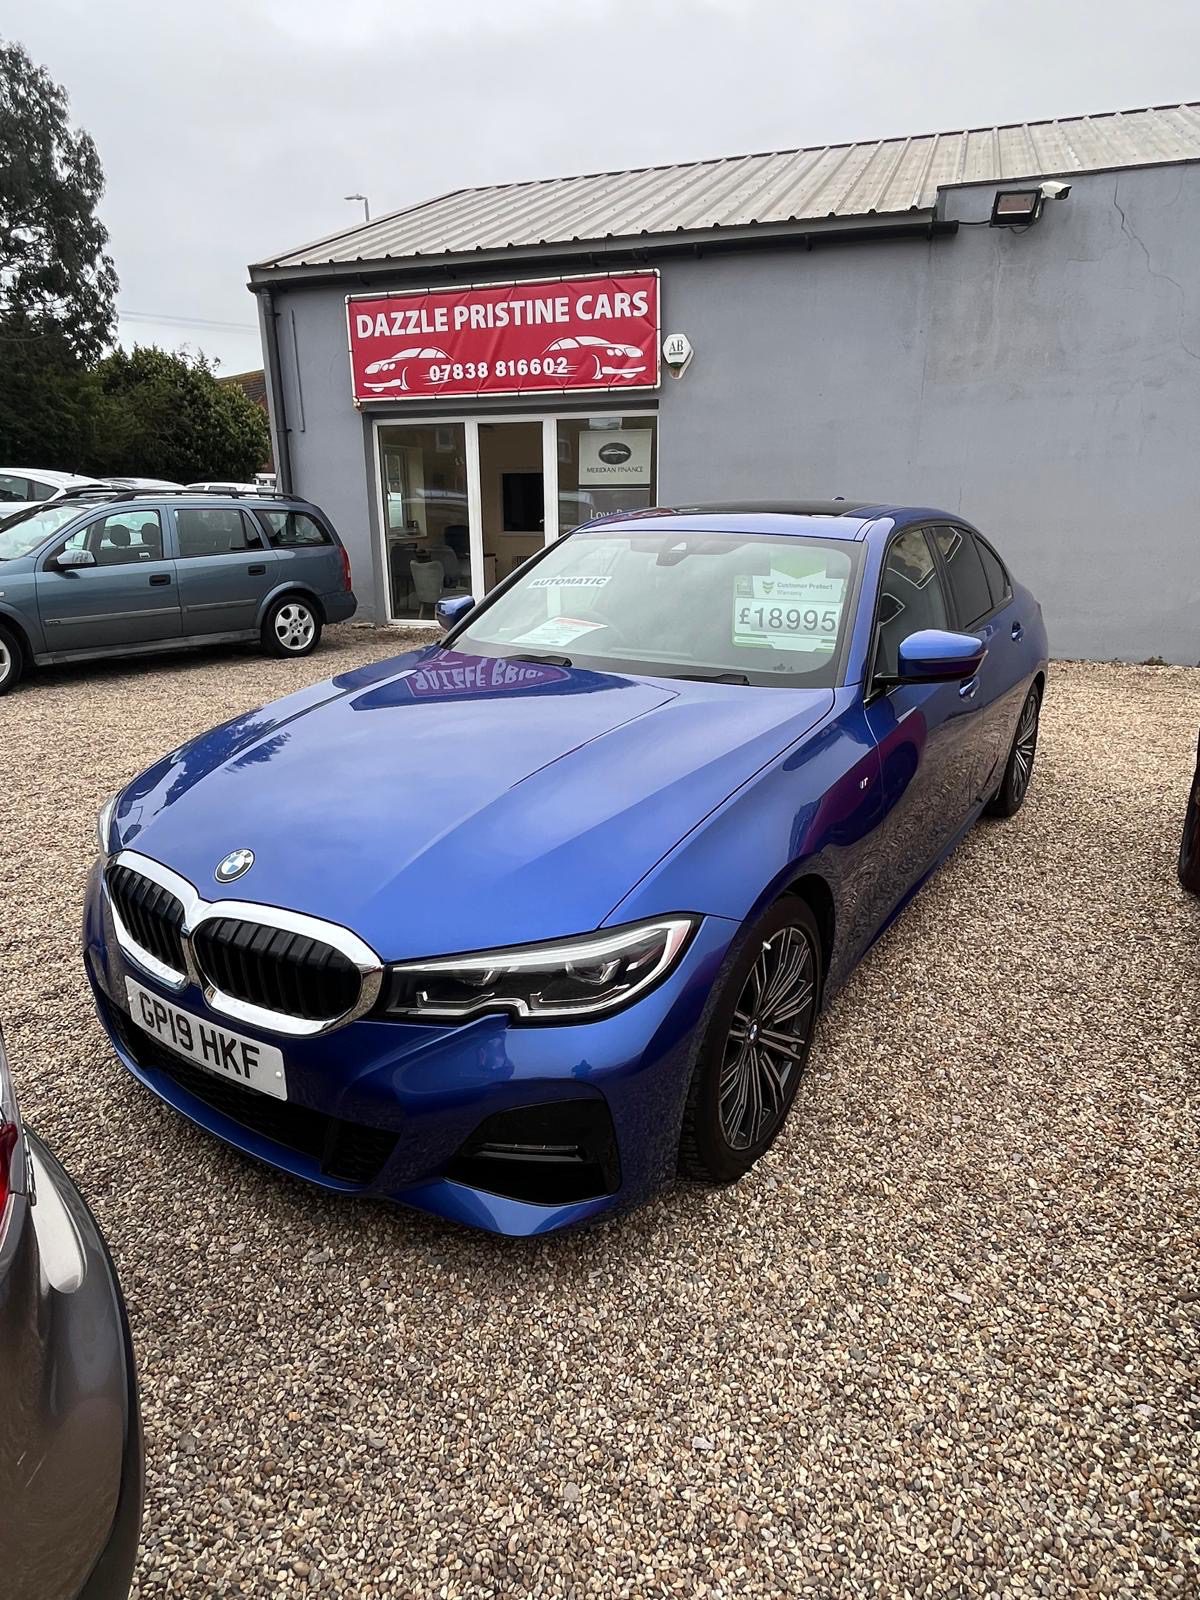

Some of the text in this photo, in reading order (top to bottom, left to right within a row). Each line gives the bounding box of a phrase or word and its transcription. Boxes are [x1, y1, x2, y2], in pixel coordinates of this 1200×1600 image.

[356, 290, 649, 339] DAZZLE PRISTINE CARS
[669, 340, 684, 352] AB
[429, 357, 569, 382] 07838 816602
[532, 577, 609, 587] AUTOMATIC
[809, 582, 833, 590] Protect
[739, 607, 837, 632] £18995
[138, 991, 260, 1079] GP19 HKF
